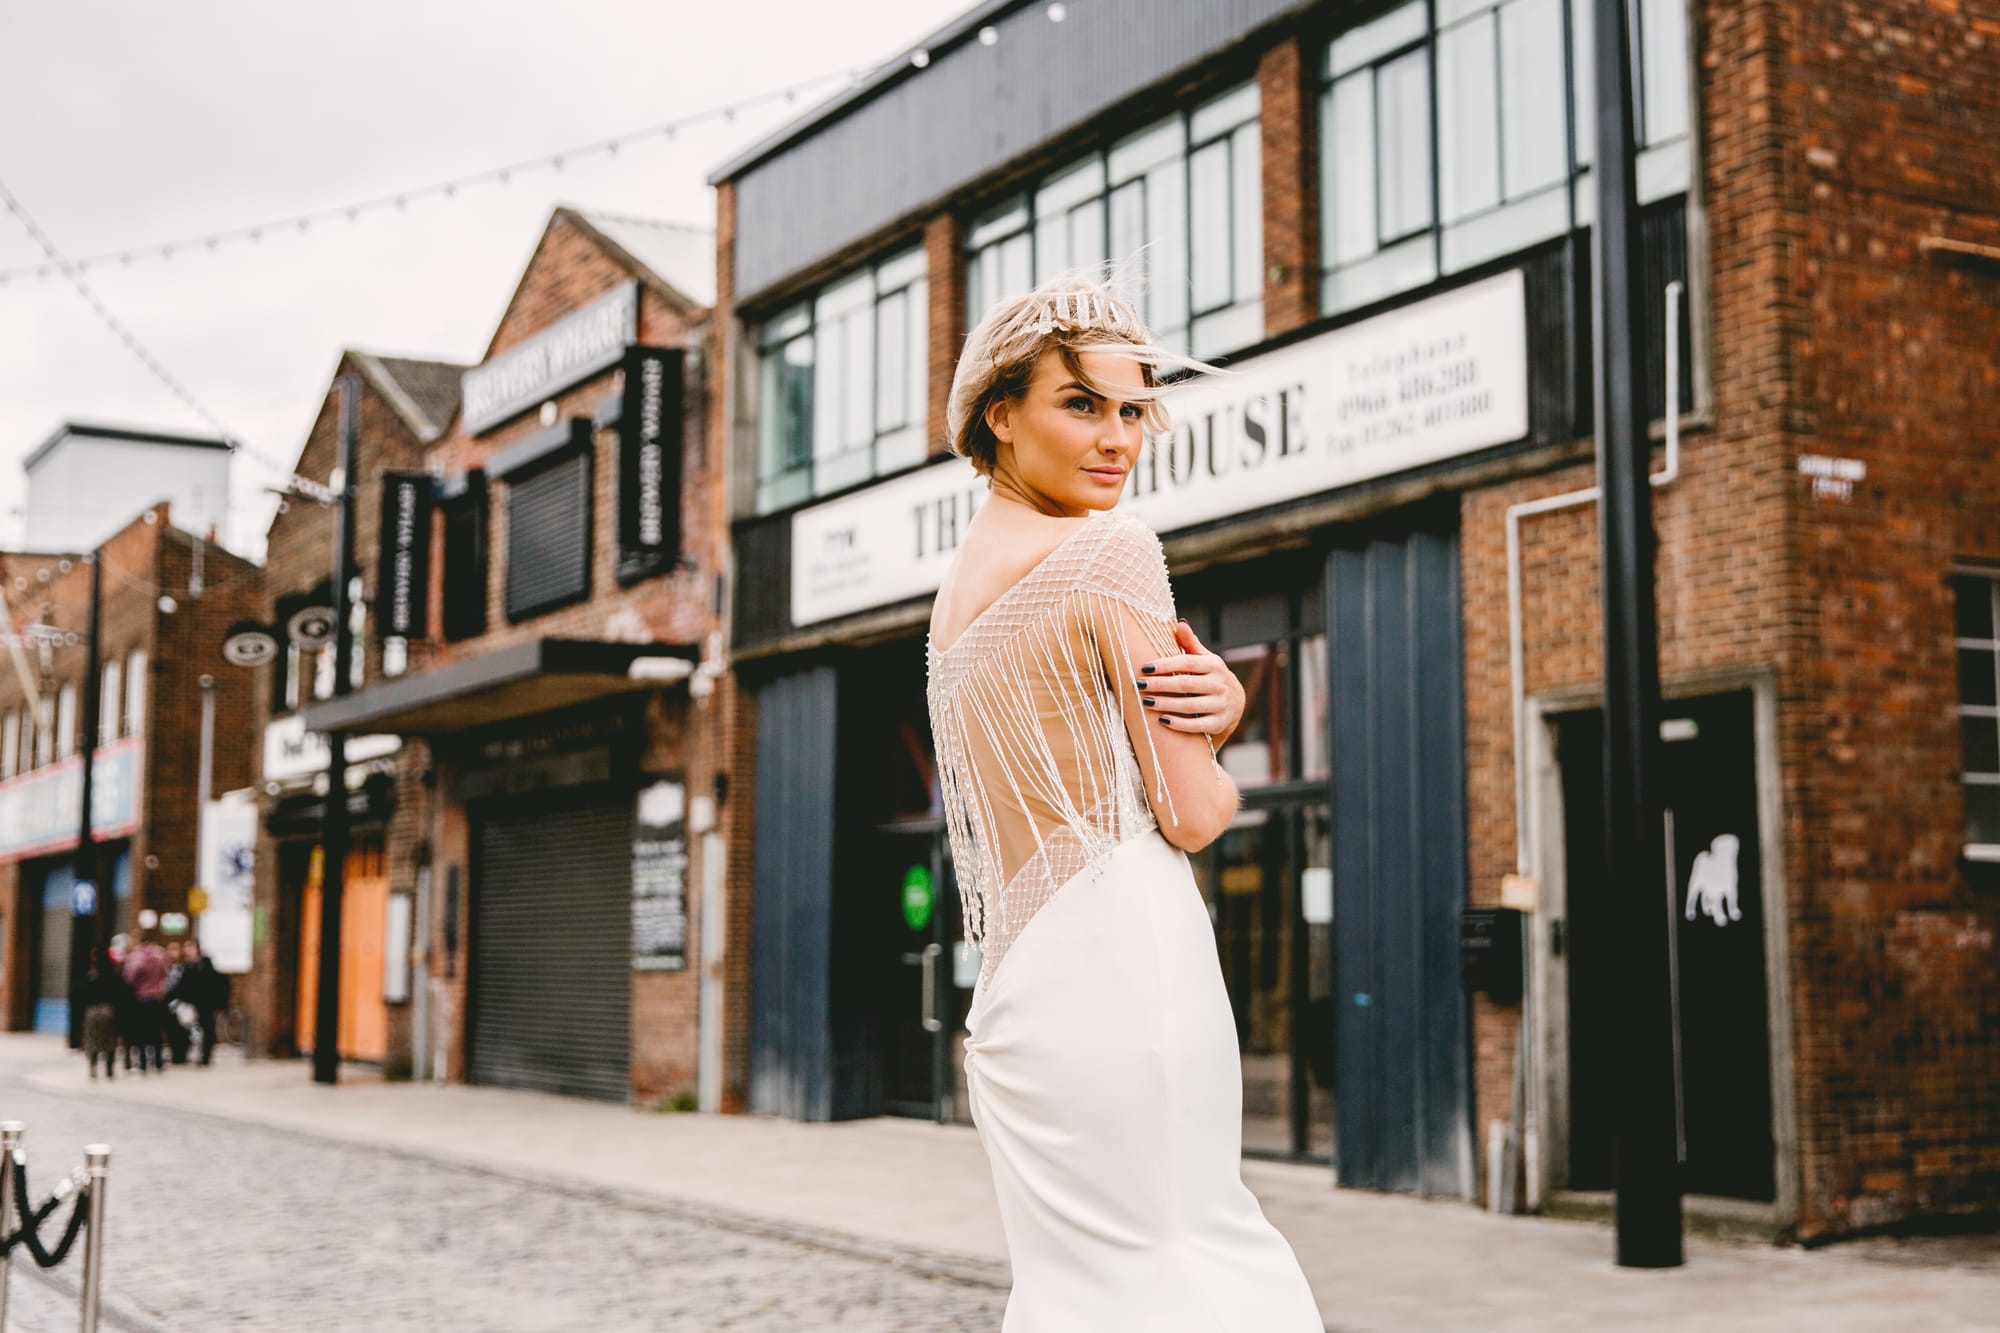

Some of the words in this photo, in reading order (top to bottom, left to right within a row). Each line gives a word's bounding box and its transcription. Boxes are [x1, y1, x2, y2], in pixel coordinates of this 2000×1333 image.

[1348, 333, 1466, 382] Telephone
[641, 358, 663, 442] WHARF
[640, 443, 662, 545] BREWERY
